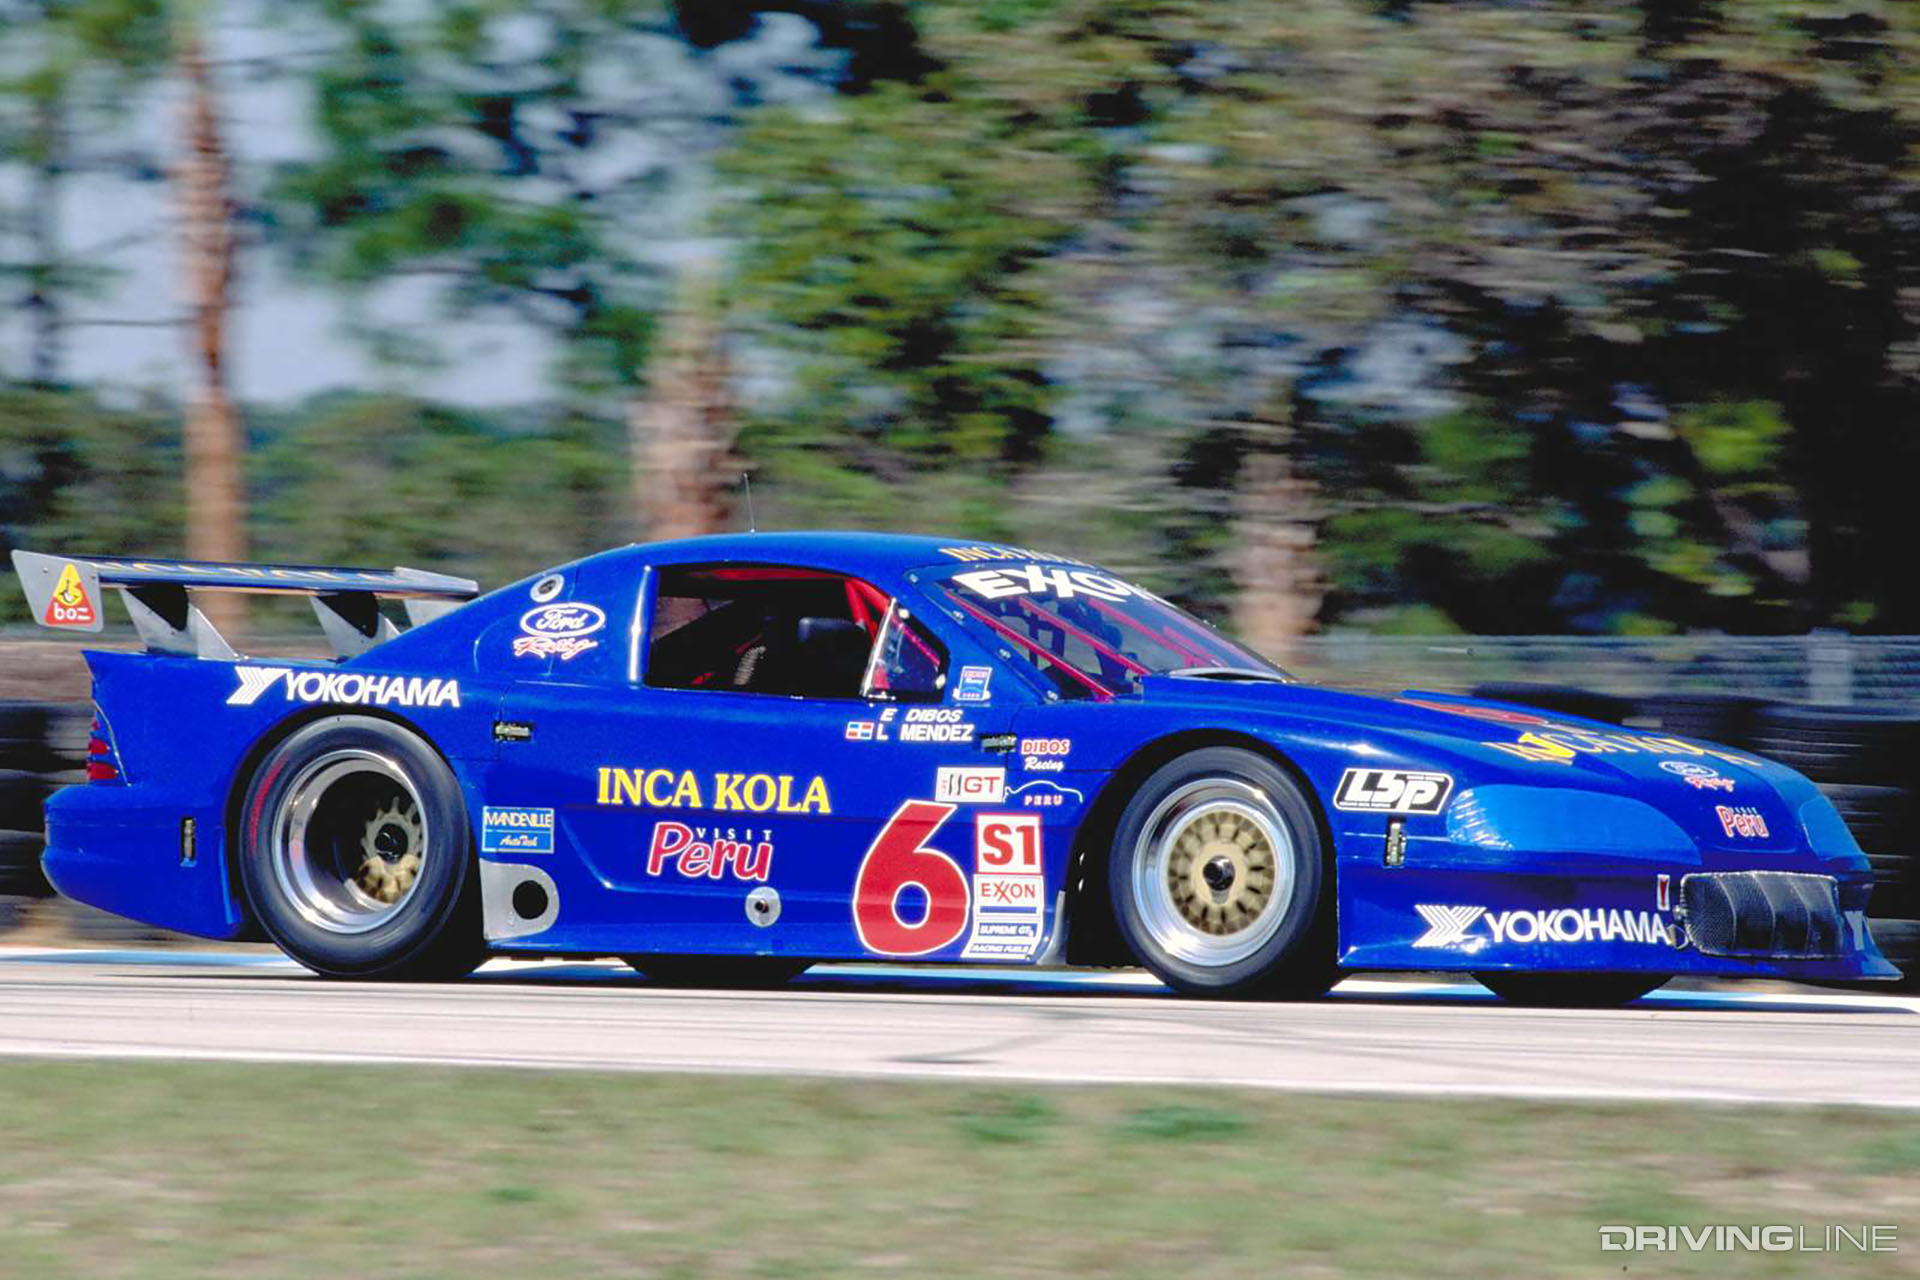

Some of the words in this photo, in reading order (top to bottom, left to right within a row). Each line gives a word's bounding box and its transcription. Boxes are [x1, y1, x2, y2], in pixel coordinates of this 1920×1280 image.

[536, 608, 589, 630] Ford
[286, 671, 461, 708] YOKOHAMA
[880, 708, 898, 722] E
[905, 708, 964, 723] DIBOS
[876, 723, 889, 741] L
[900, 723, 975, 742] MENDEZ
[1021, 739, 1071, 755] DIBOS
[597, 767, 702, 808] INCA
[713, 772, 832, 814] KOLA
[963, 776, 1001, 794] GT
[1024, 795, 1063, 806] PERU
[1715, 805, 1770, 838] Peru
[695, 827, 773, 841] VISIT
[982, 823, 1036, 866] S1
[646, 821, 773, 882] Peru
[853, 799, 971, 955] 6
[980, 880, 1036, 904] EXXON
[1484, 907, 1672, 946] YOKOHAMA
